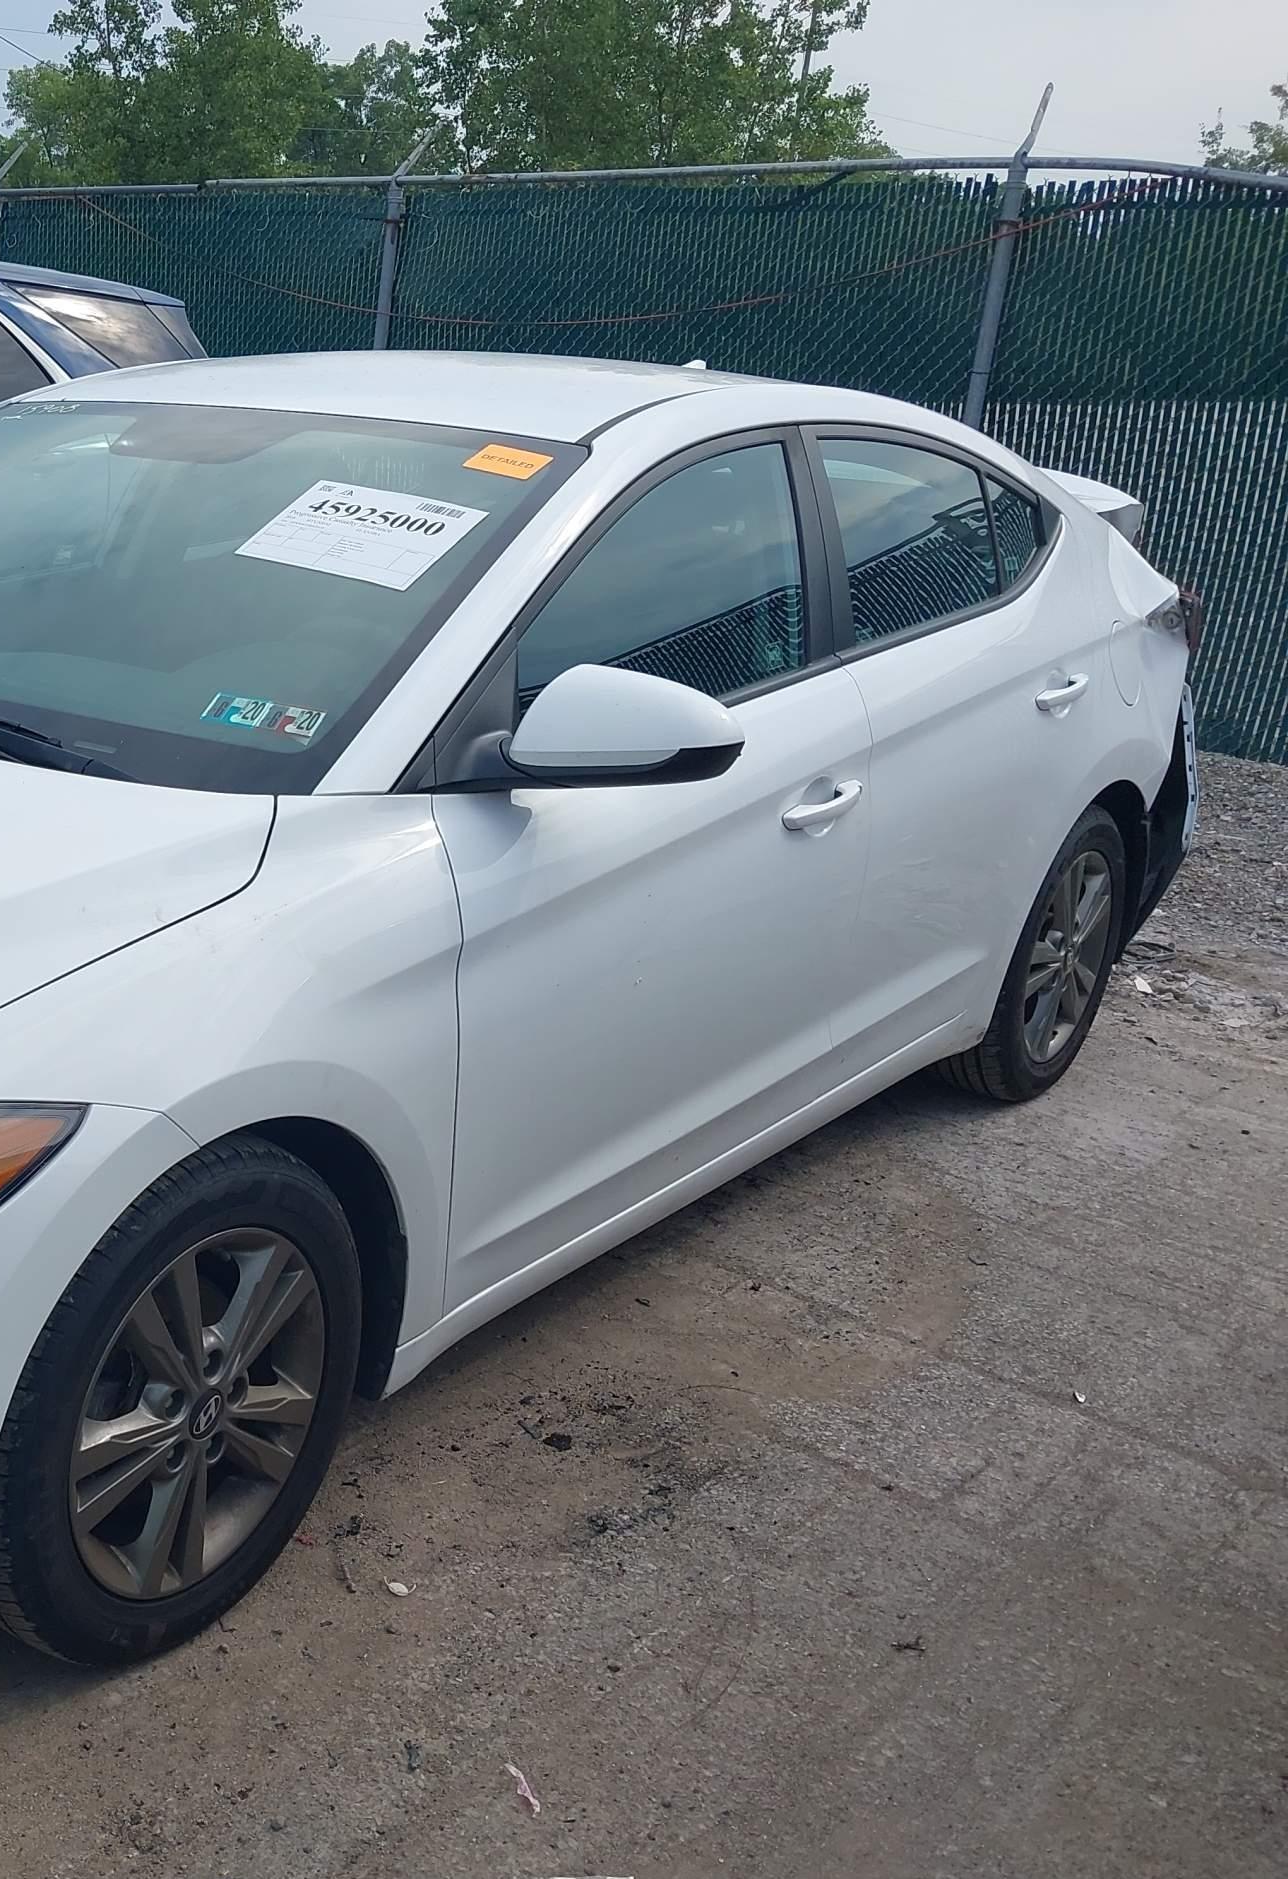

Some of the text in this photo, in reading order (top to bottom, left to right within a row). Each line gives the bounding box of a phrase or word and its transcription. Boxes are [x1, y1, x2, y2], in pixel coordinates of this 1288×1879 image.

[481, 453, 535, 469] DETAILED
[308, 499, 446, 536] 45925000
[242, 701, 265, 721] 20
[296, 711, 322, 731] 20
